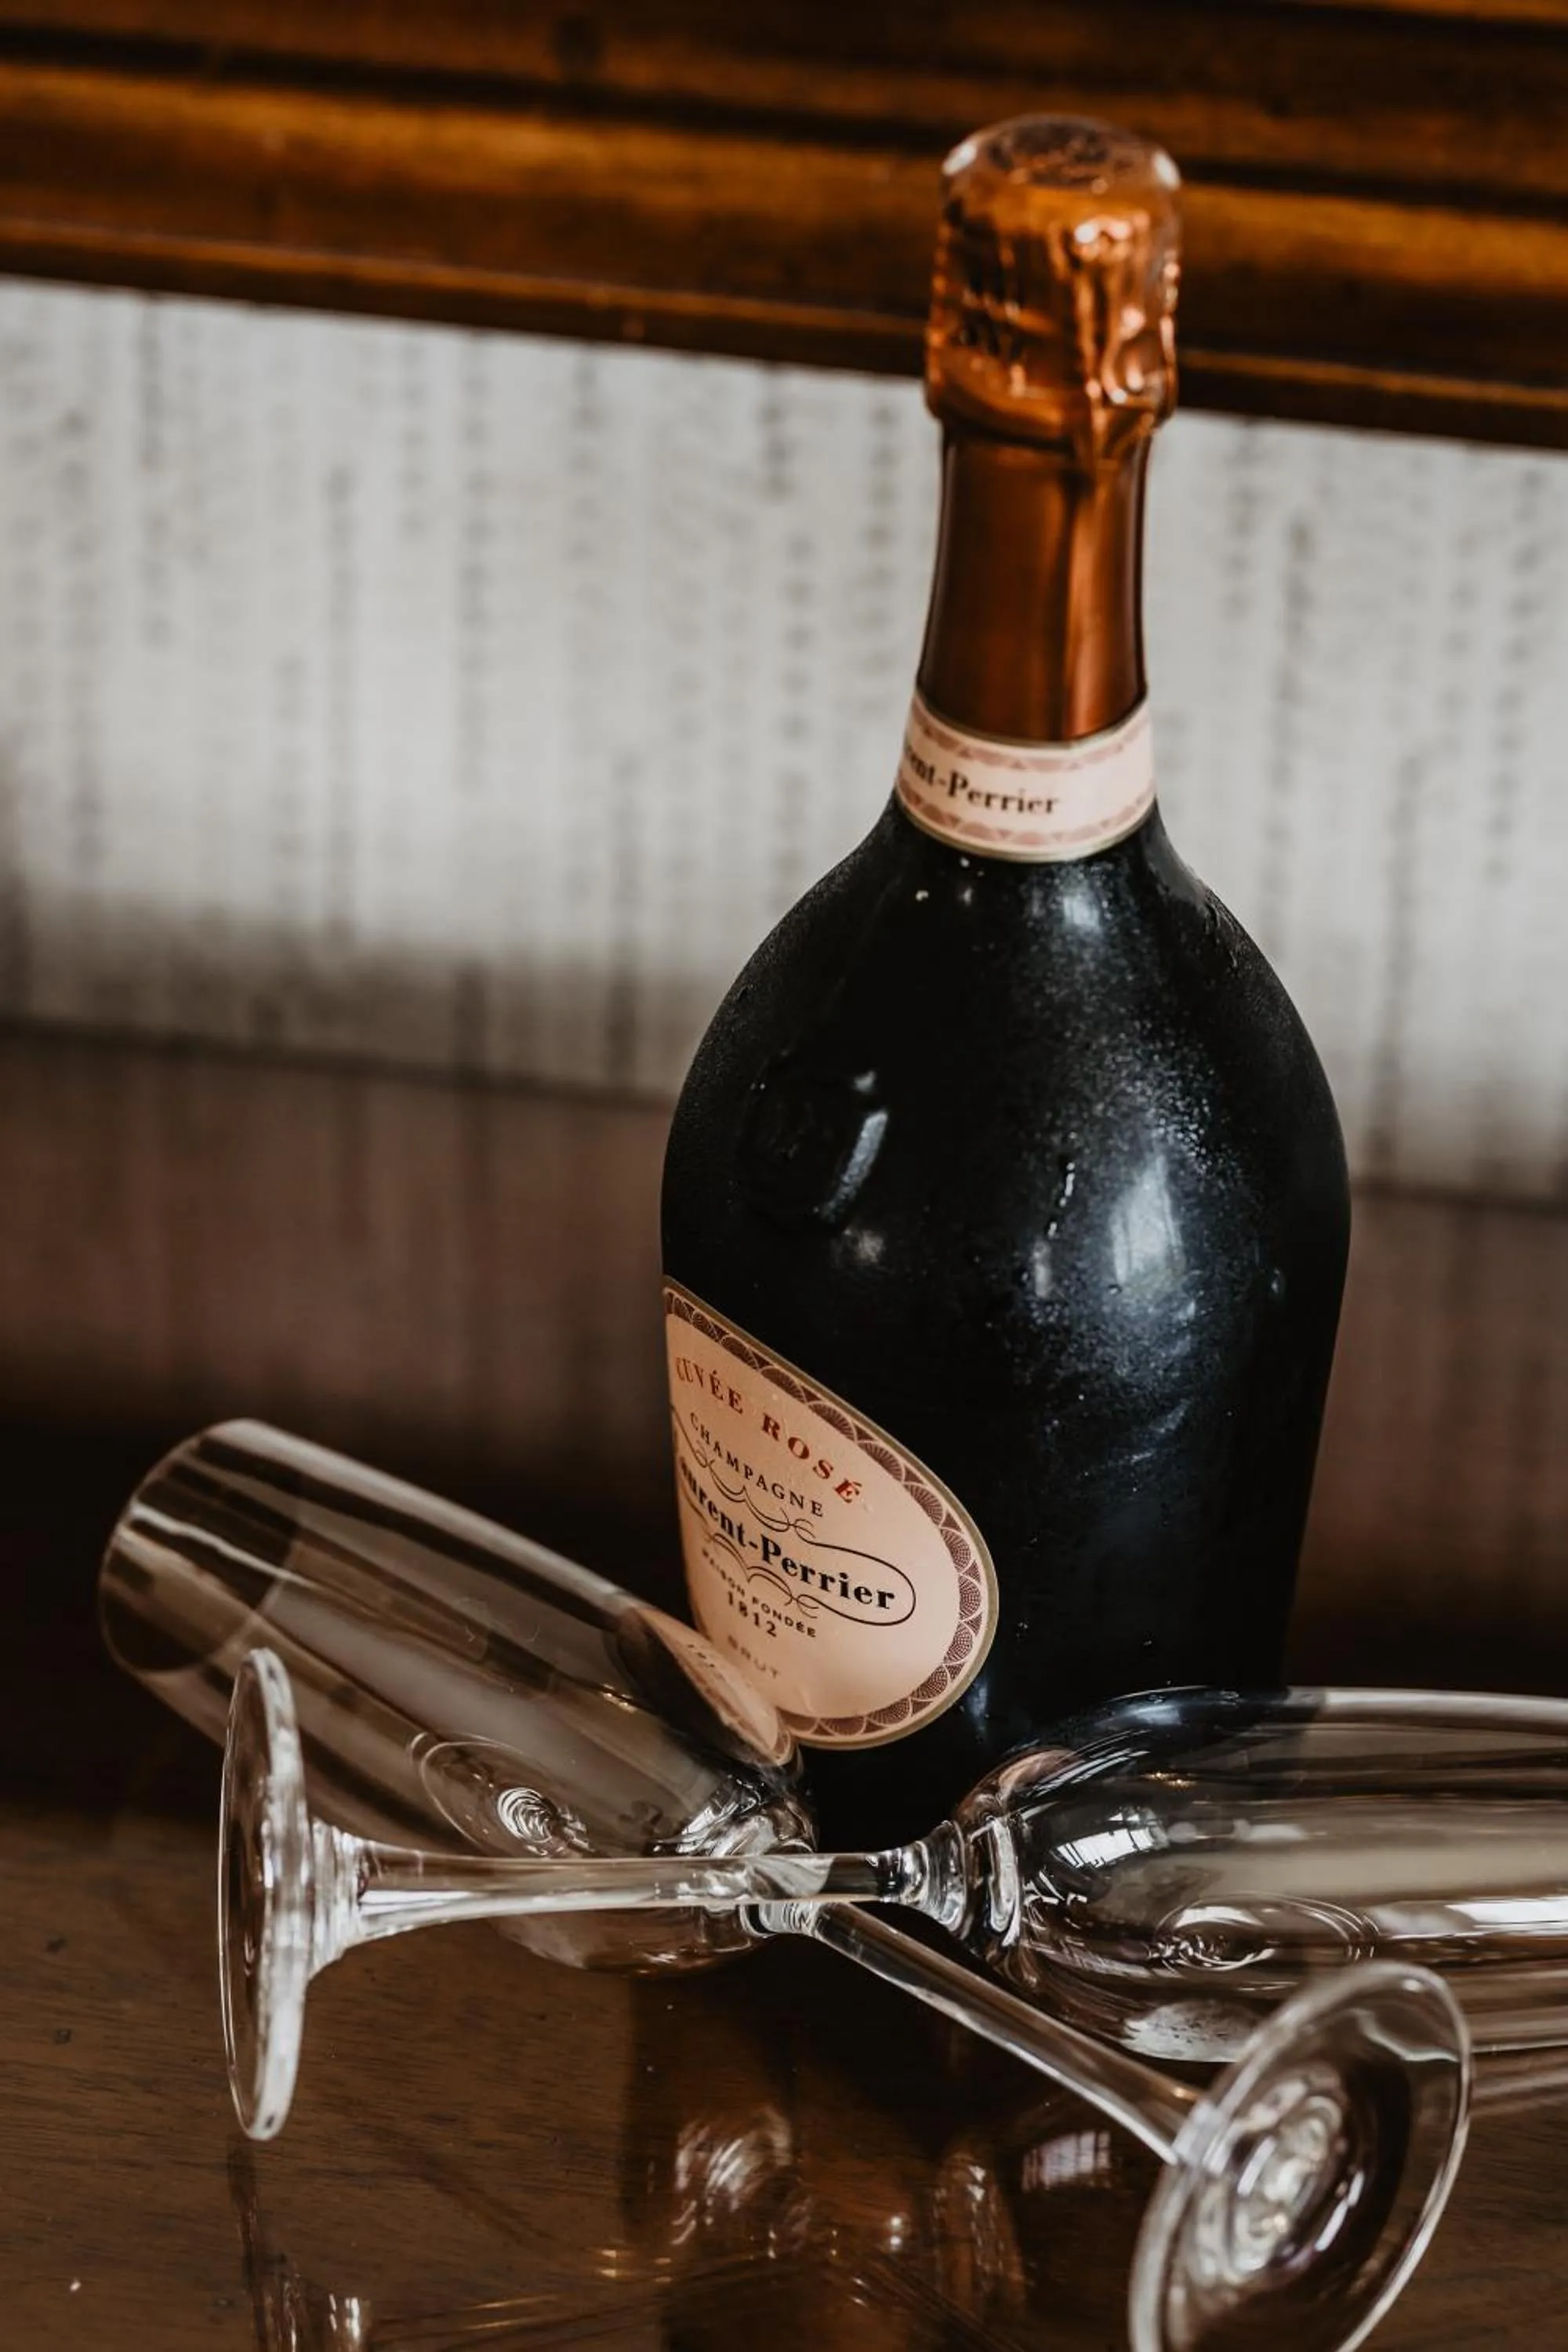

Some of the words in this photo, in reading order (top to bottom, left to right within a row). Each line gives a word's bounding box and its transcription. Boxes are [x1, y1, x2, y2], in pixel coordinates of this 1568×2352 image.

[676, 1357, 743, 1414] CUVÉE
[762, 1413, 862, 1504] ROSÉ
[691, 1412, 823, 1517] CHAMPAGNE
[727, 1590, 777, 1638] 1812
[752, 1595, 817, 1638] FONDÉE
